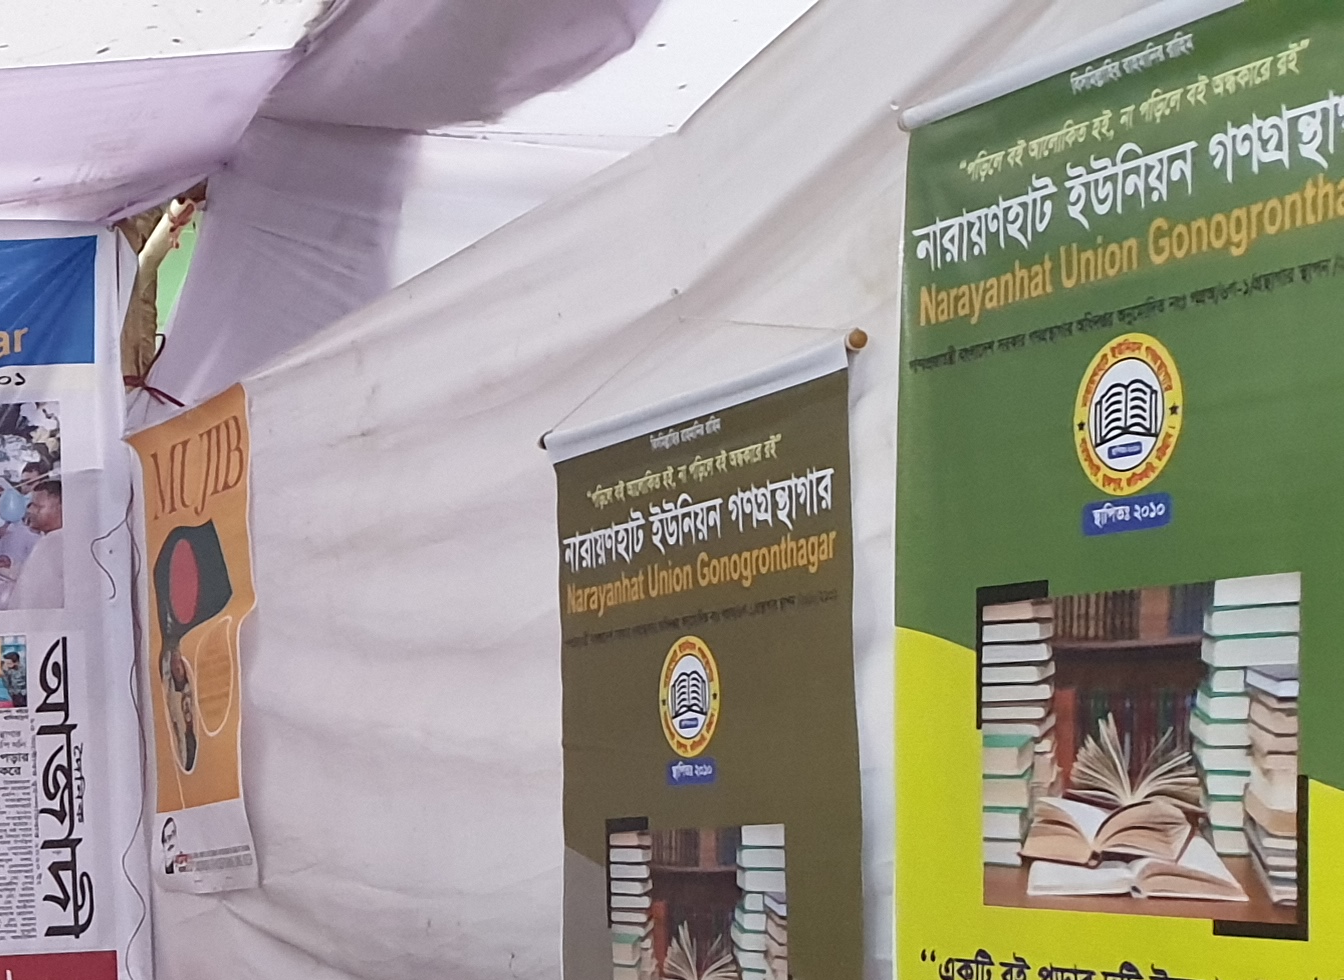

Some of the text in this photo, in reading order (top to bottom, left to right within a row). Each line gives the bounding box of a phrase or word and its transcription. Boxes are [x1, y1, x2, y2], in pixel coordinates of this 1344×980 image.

[1064, 142, 1199, 231] ইউনিয়ন
[919, 251, 1053, 327] Narayanhat
[1060, 235, 1138, 289] Union
[150, 415, 244, 521] MUJIB
[1134, 501, 1165, 522] ২০১০
[648, 493, 723, 555] ইউনিয়ন
[566, 529, 837, 617] Narayanhat Union Gonogronthagar
